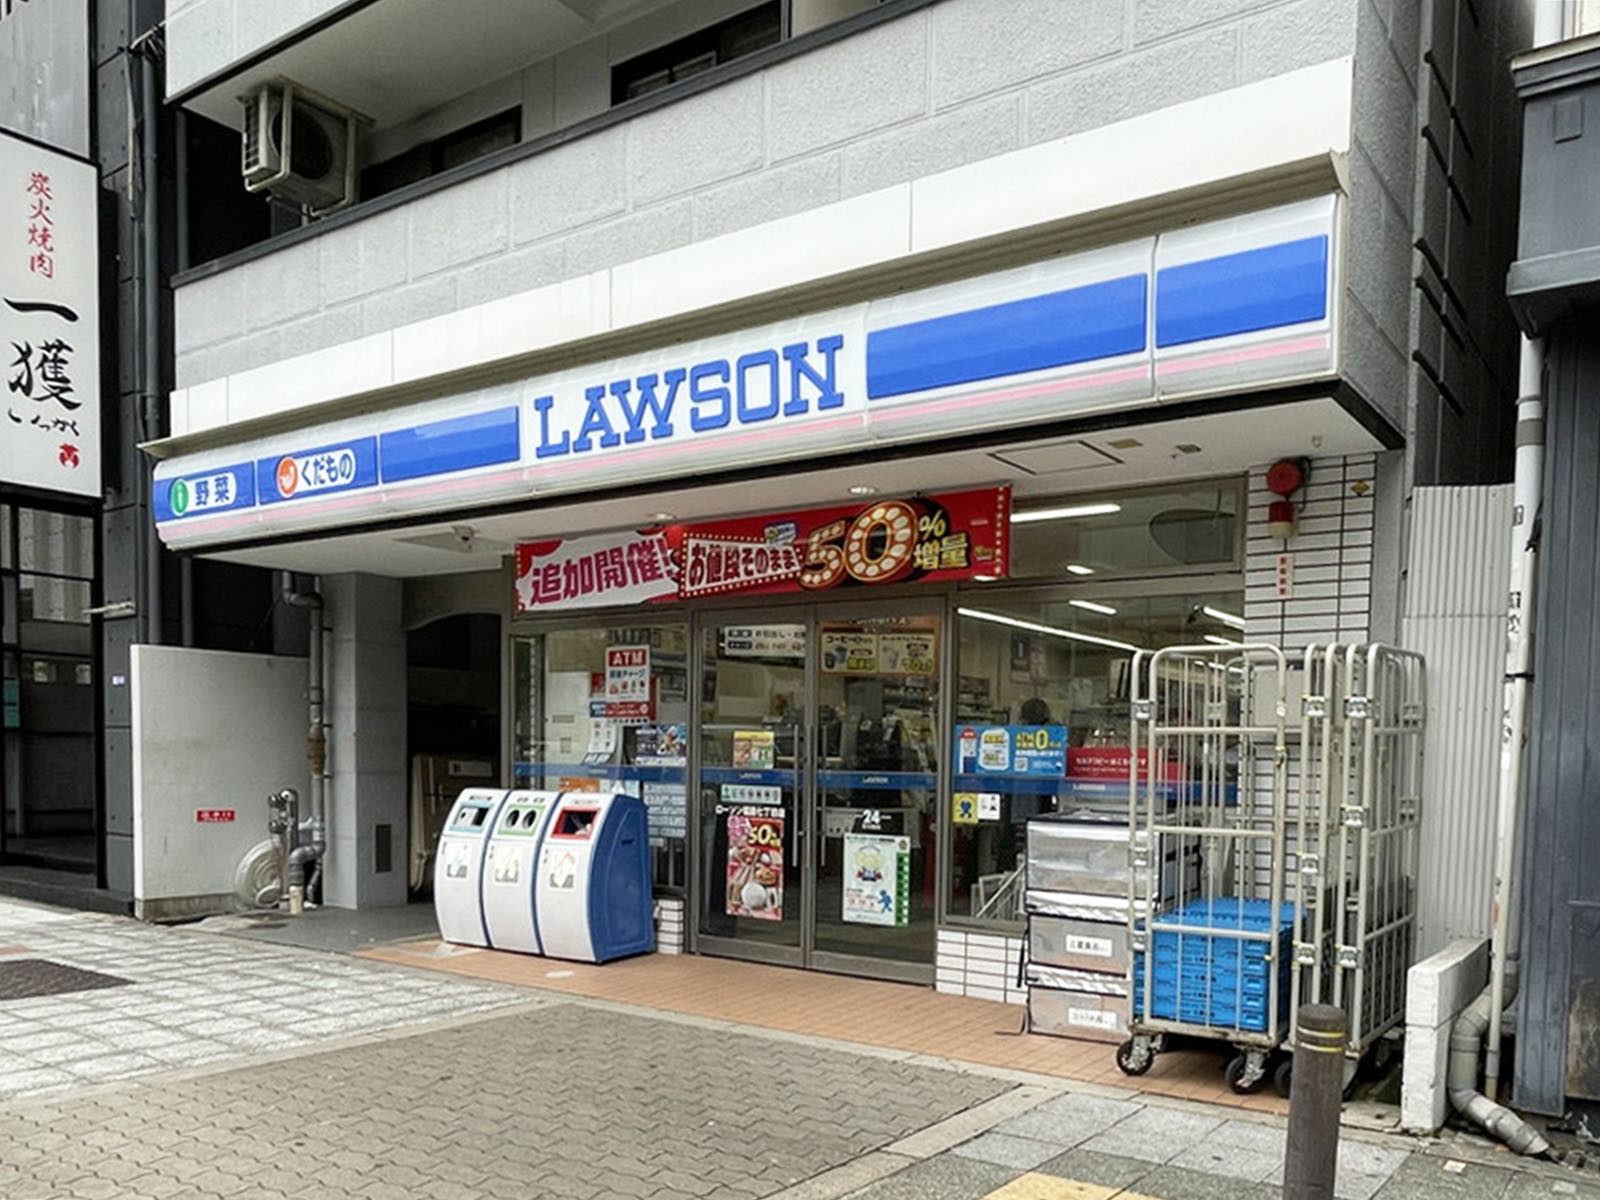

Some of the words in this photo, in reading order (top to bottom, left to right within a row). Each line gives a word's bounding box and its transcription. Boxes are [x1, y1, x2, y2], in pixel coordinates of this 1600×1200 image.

[27, 172, 54, 279] 炭火焼肉
[3, 297, 83, 412] 一獲
[534, 334, 844, 459] LAWSON
[195, 475, 231, 506] 野菜
[301, 452, 352, 487] くだもの
[689, 543, 796, 588] お値段そのまま
[612, 650, 643, 665] ATM
